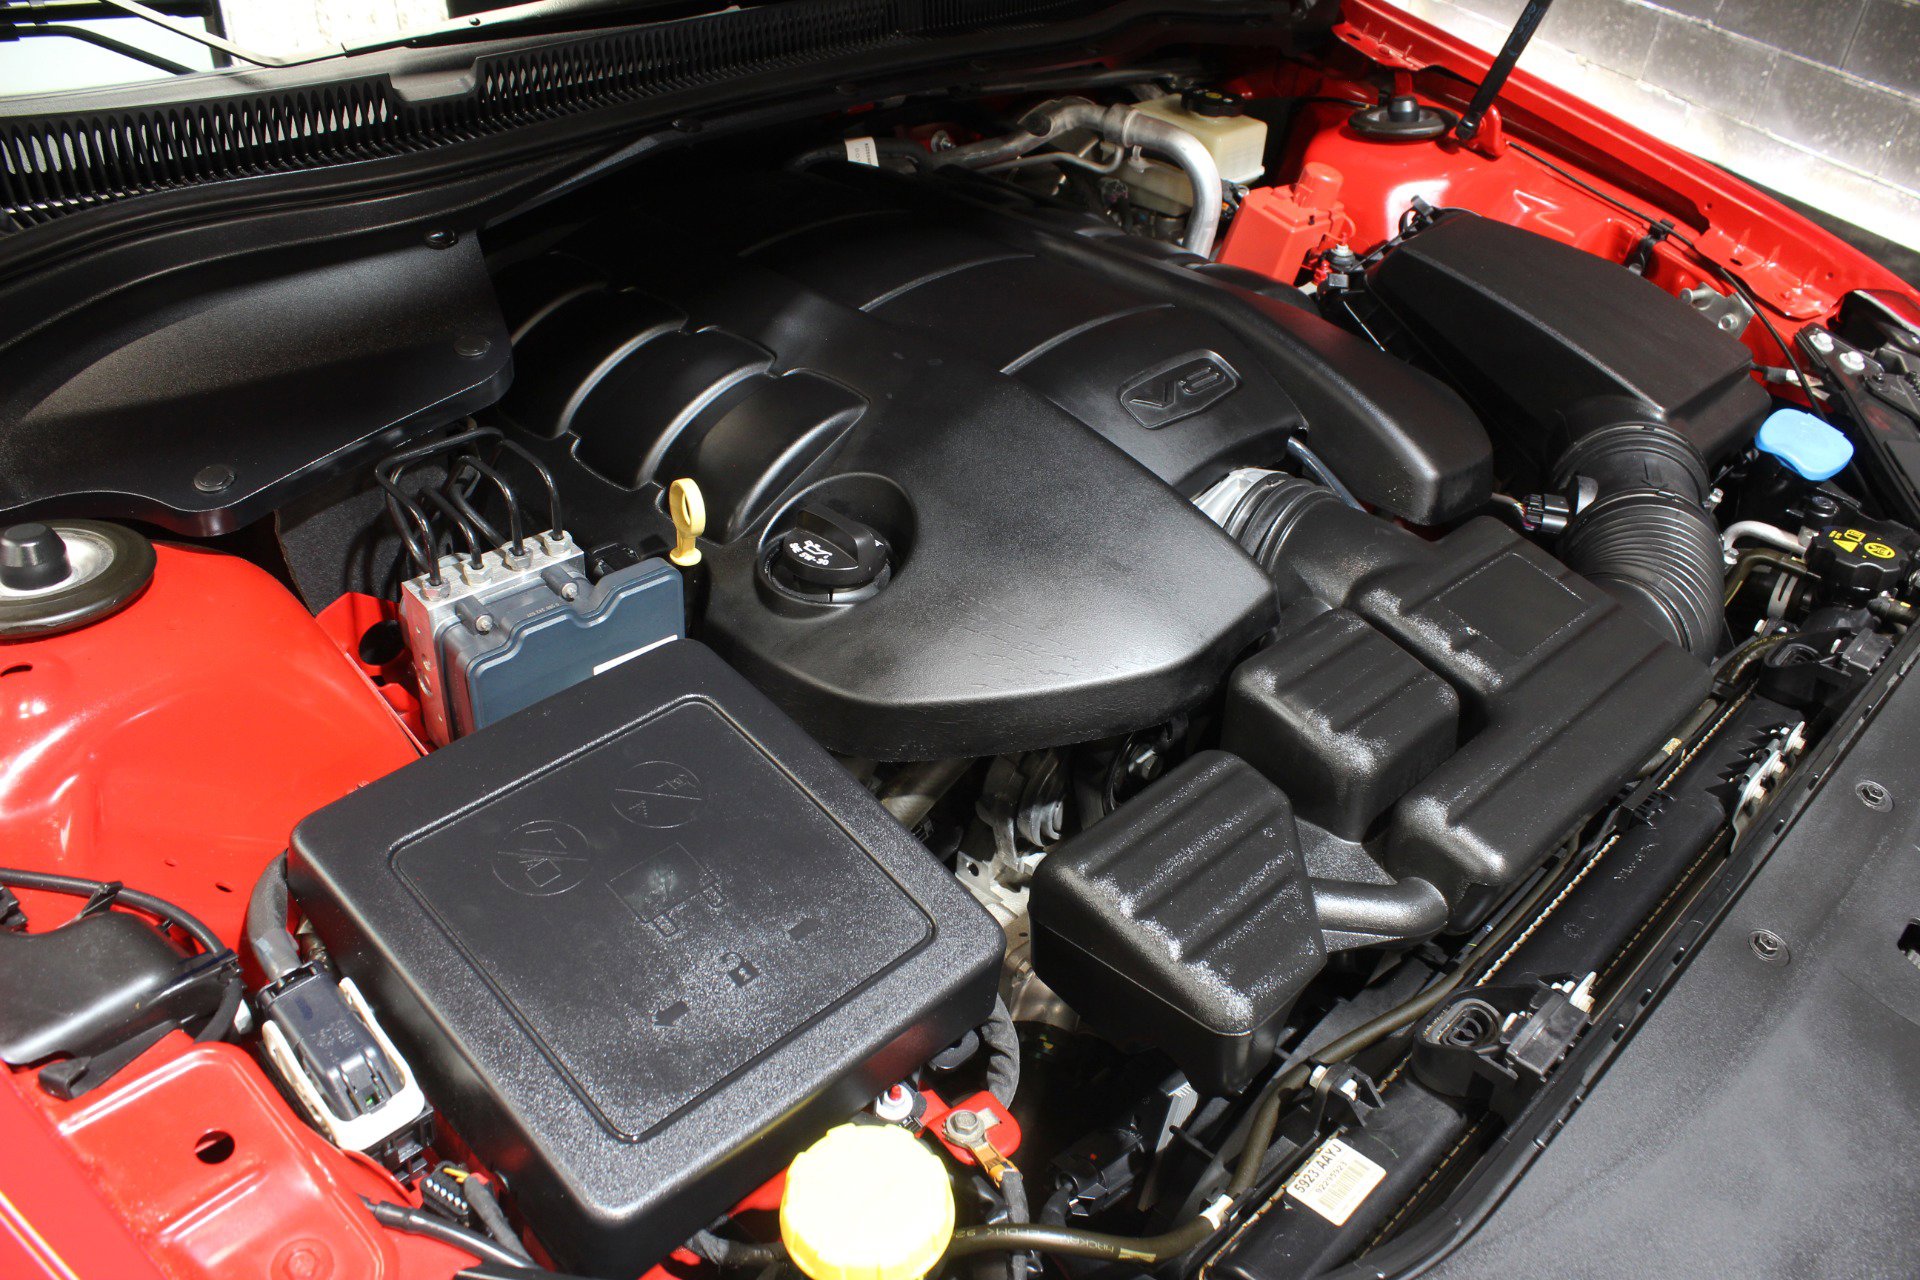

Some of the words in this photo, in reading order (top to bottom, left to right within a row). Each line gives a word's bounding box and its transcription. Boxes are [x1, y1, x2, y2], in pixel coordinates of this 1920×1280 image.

[1128, 365, 1226, 410] V8
[799, 552, 830, 566] 5W-30
[1294, 1169, 1320, 1193] 5923
[1315, 1143, 1342, 1170] AAYJ
